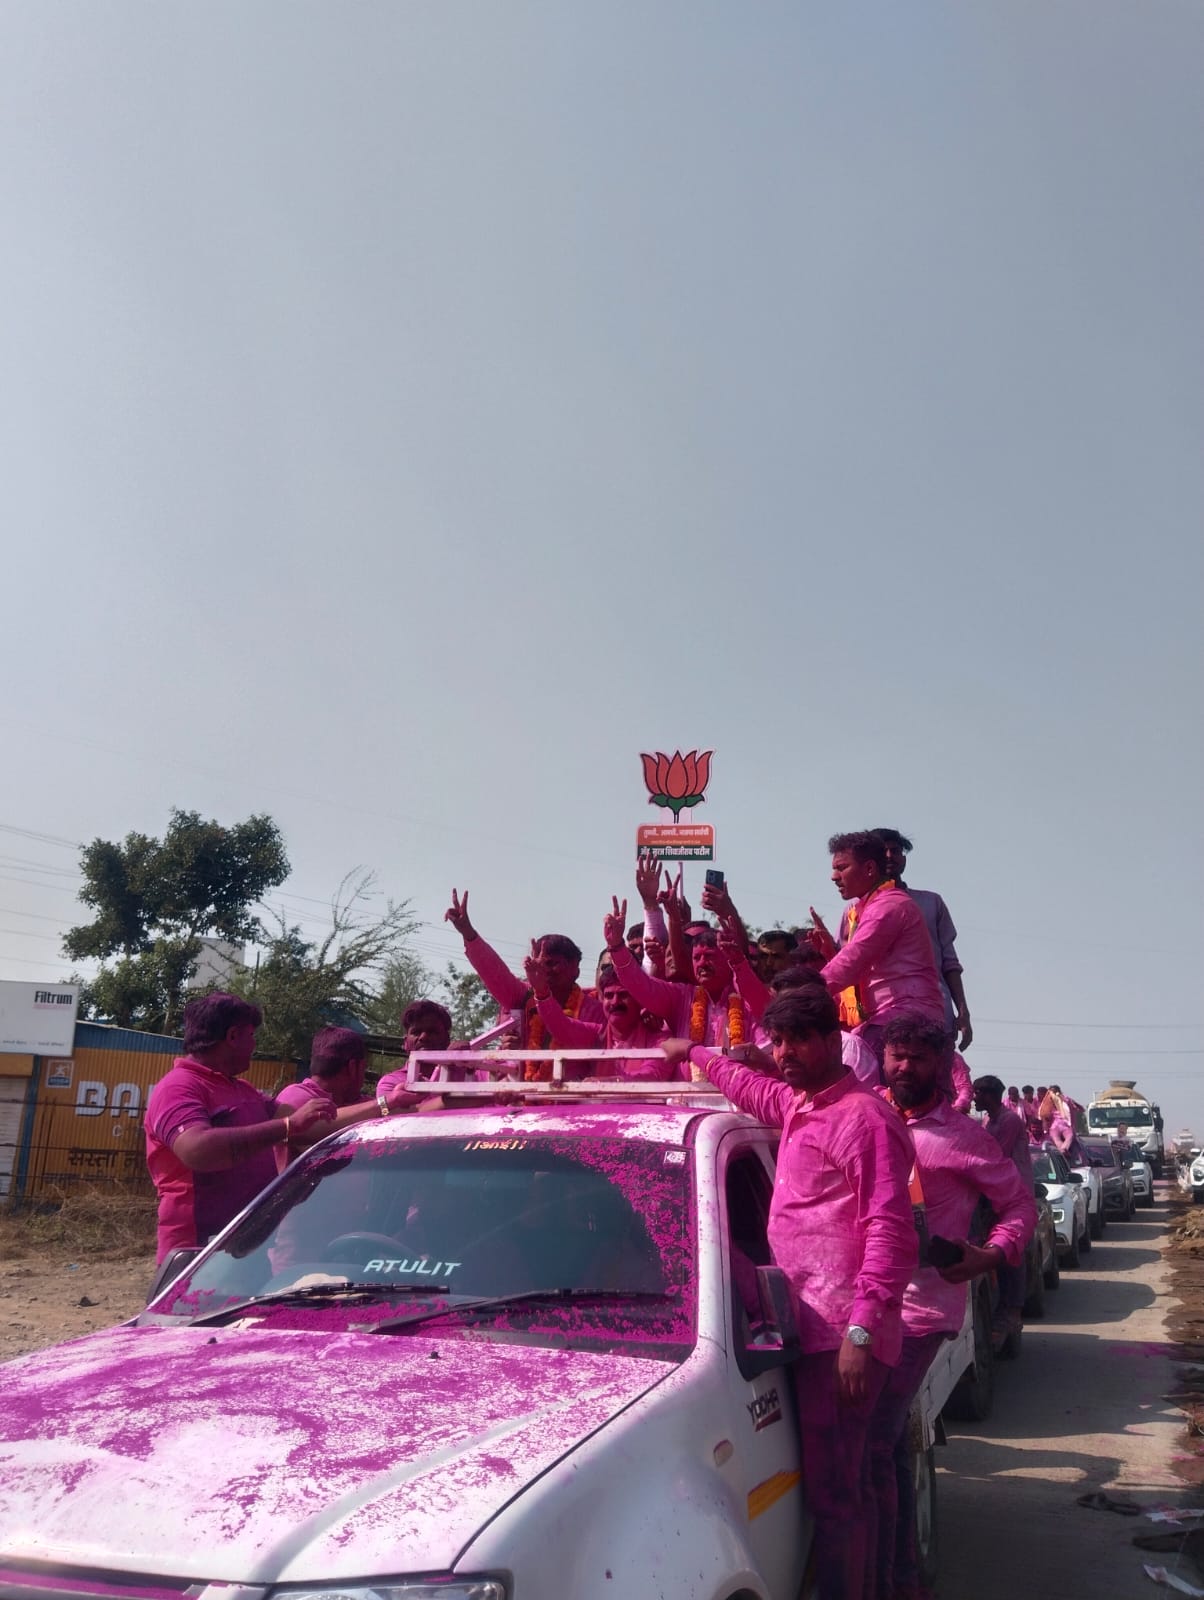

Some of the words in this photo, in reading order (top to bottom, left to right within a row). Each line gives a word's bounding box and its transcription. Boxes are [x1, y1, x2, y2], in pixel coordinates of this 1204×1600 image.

[693, 845, 710, 856] पाटील
[34, 990, 73, 1005] Filtrum
[76, 1081, 156, 1117] BA
[363, 1259, 462, 1276] ATULIT
[746, 1388, 779, 1426] YODHA
